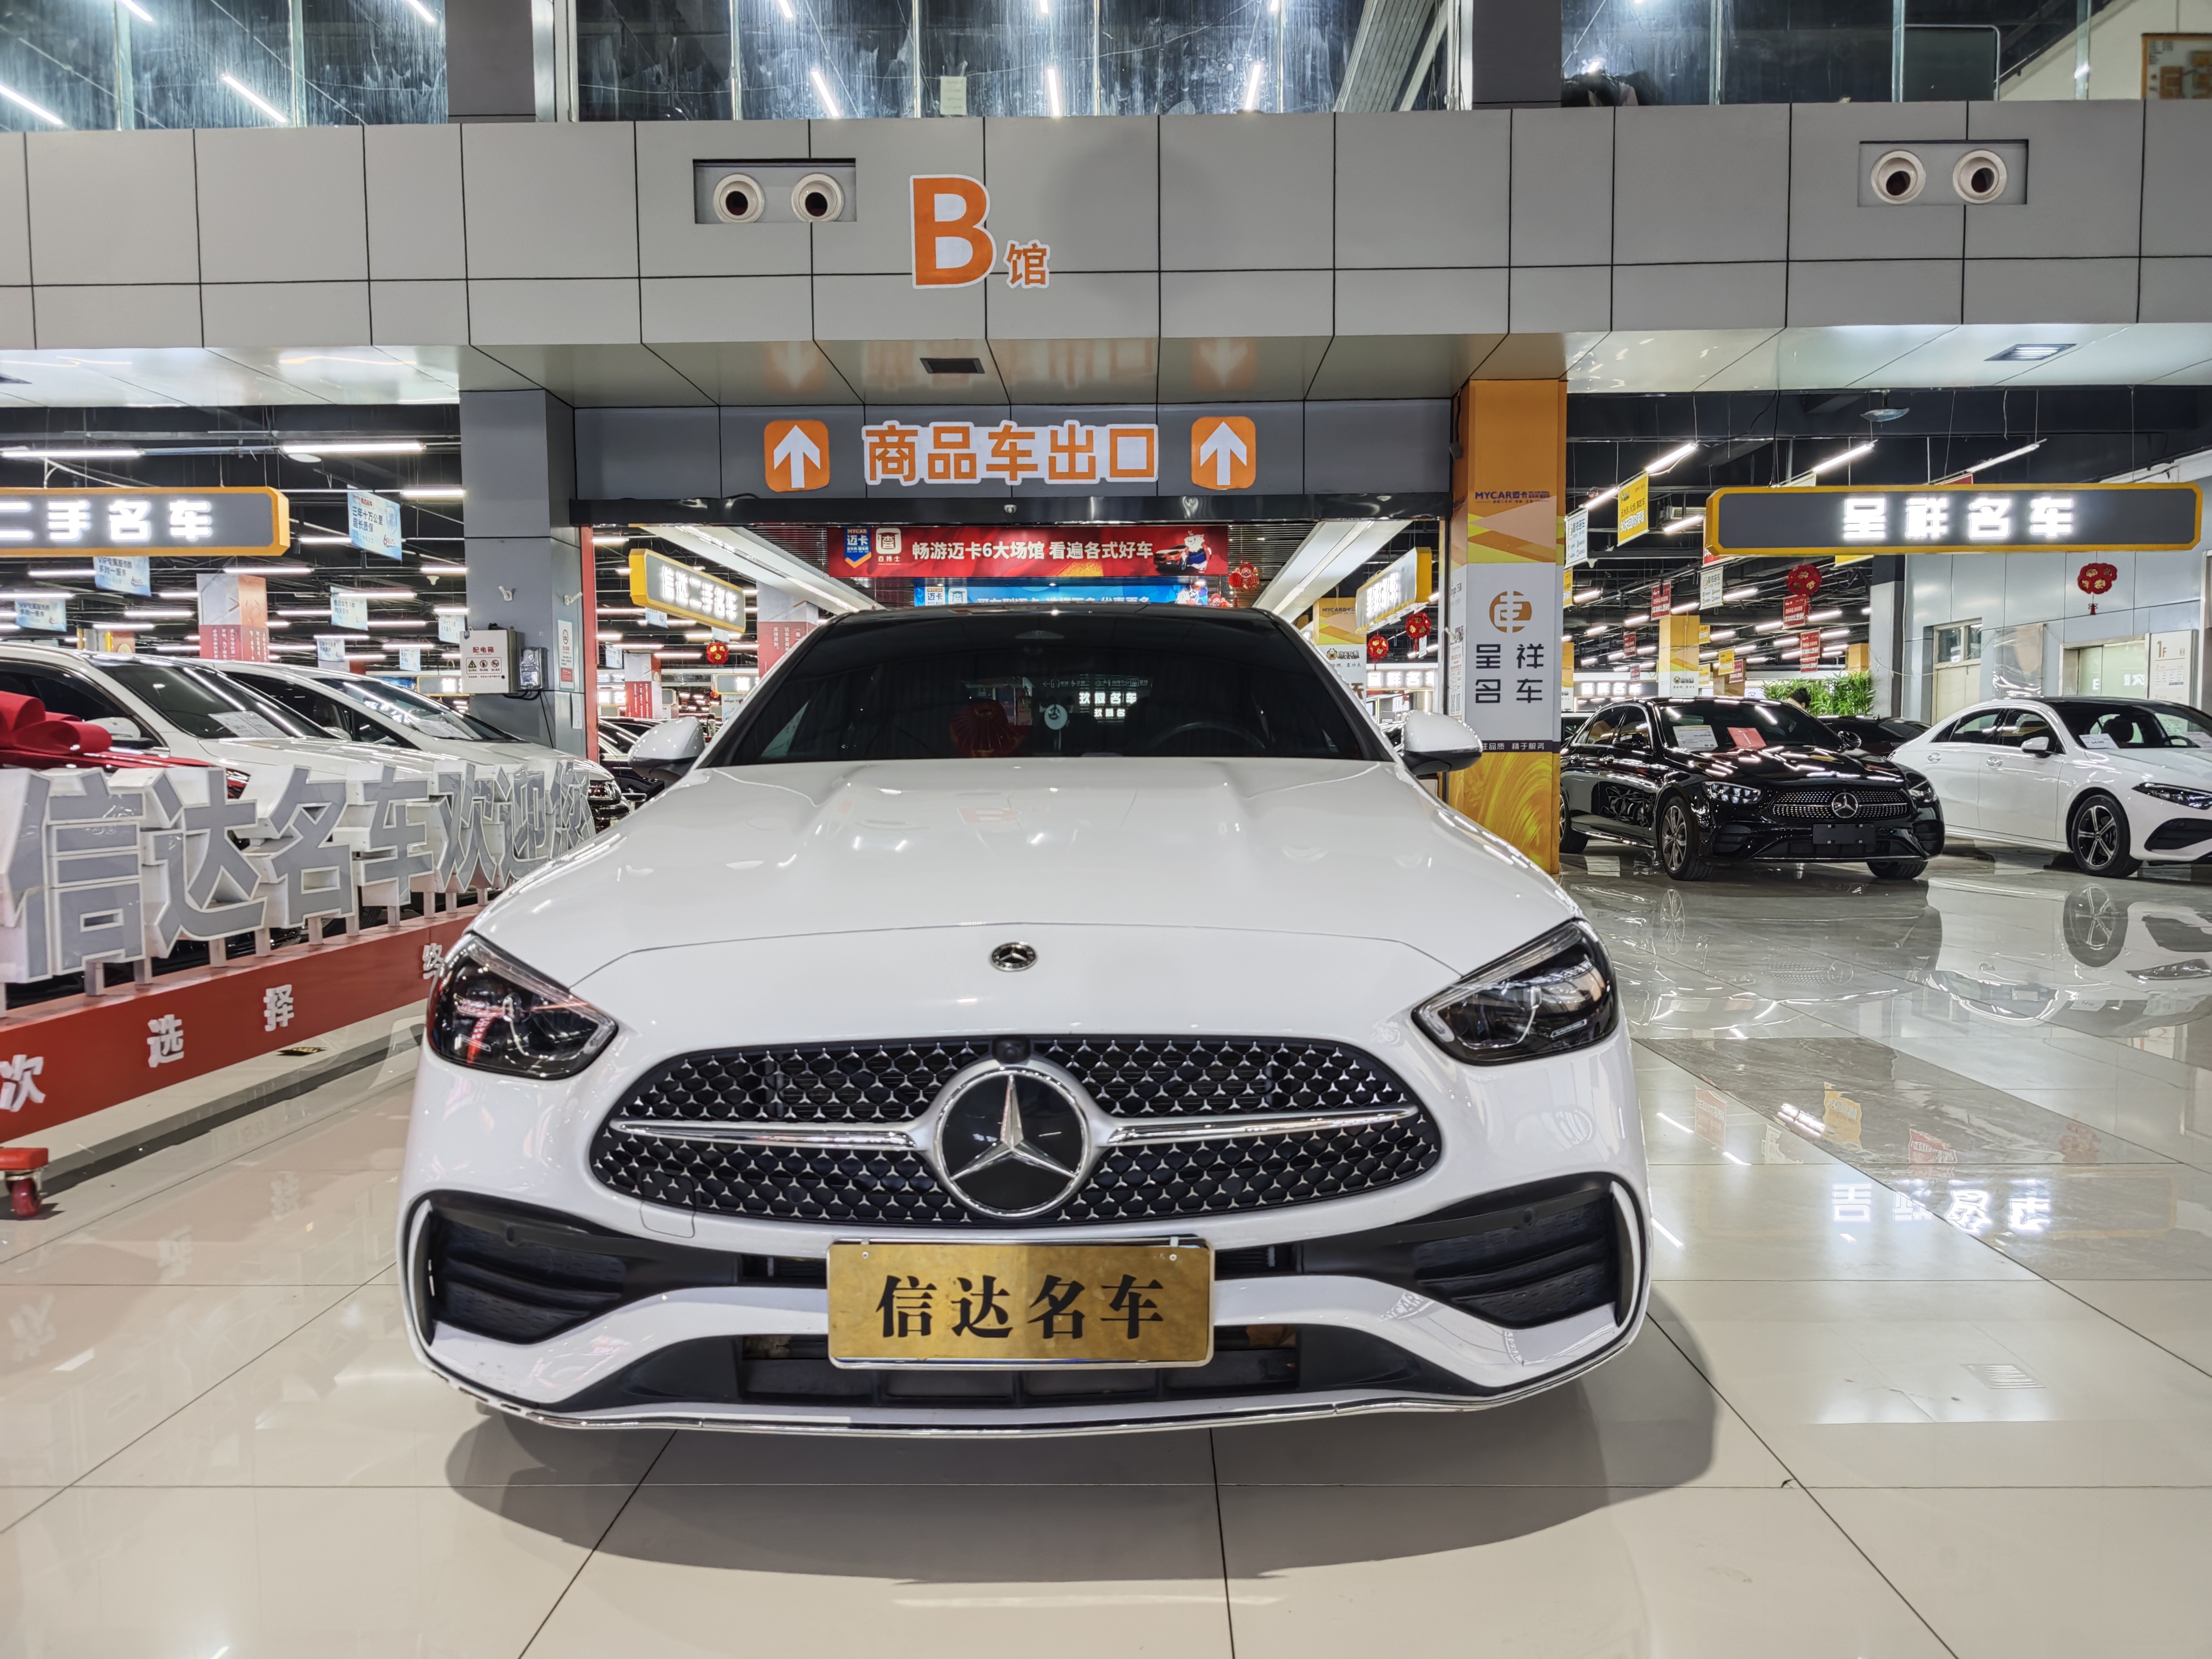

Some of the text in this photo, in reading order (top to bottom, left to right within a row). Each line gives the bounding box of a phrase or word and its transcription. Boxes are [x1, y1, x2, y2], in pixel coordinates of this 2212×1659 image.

[863, 421, 1158, 485] 商品车出口
[0, 500, 212, 541] 二手名车
[352, 506, 383, 525] 三年十万公里
[353, 517, 374, 532] 超长质保
[1843, 497, 2074, 539] 呈祥名车
[847, 535, 868, 545] 迈卡
[912, 541, 1154, 560] 畅游迈卡6大场馆 看遍各式好车
[927, 592, 943, 601] 迈卡
[1476, 643, 1544, 669] 呈祥
[2157, 640, 2167, 658] 1F
[1475, 678, 1543, 704] 名车
[1512, 742, 1545, 750] 精于服务
[875, 1273, 1164, 1339] 信达名车
